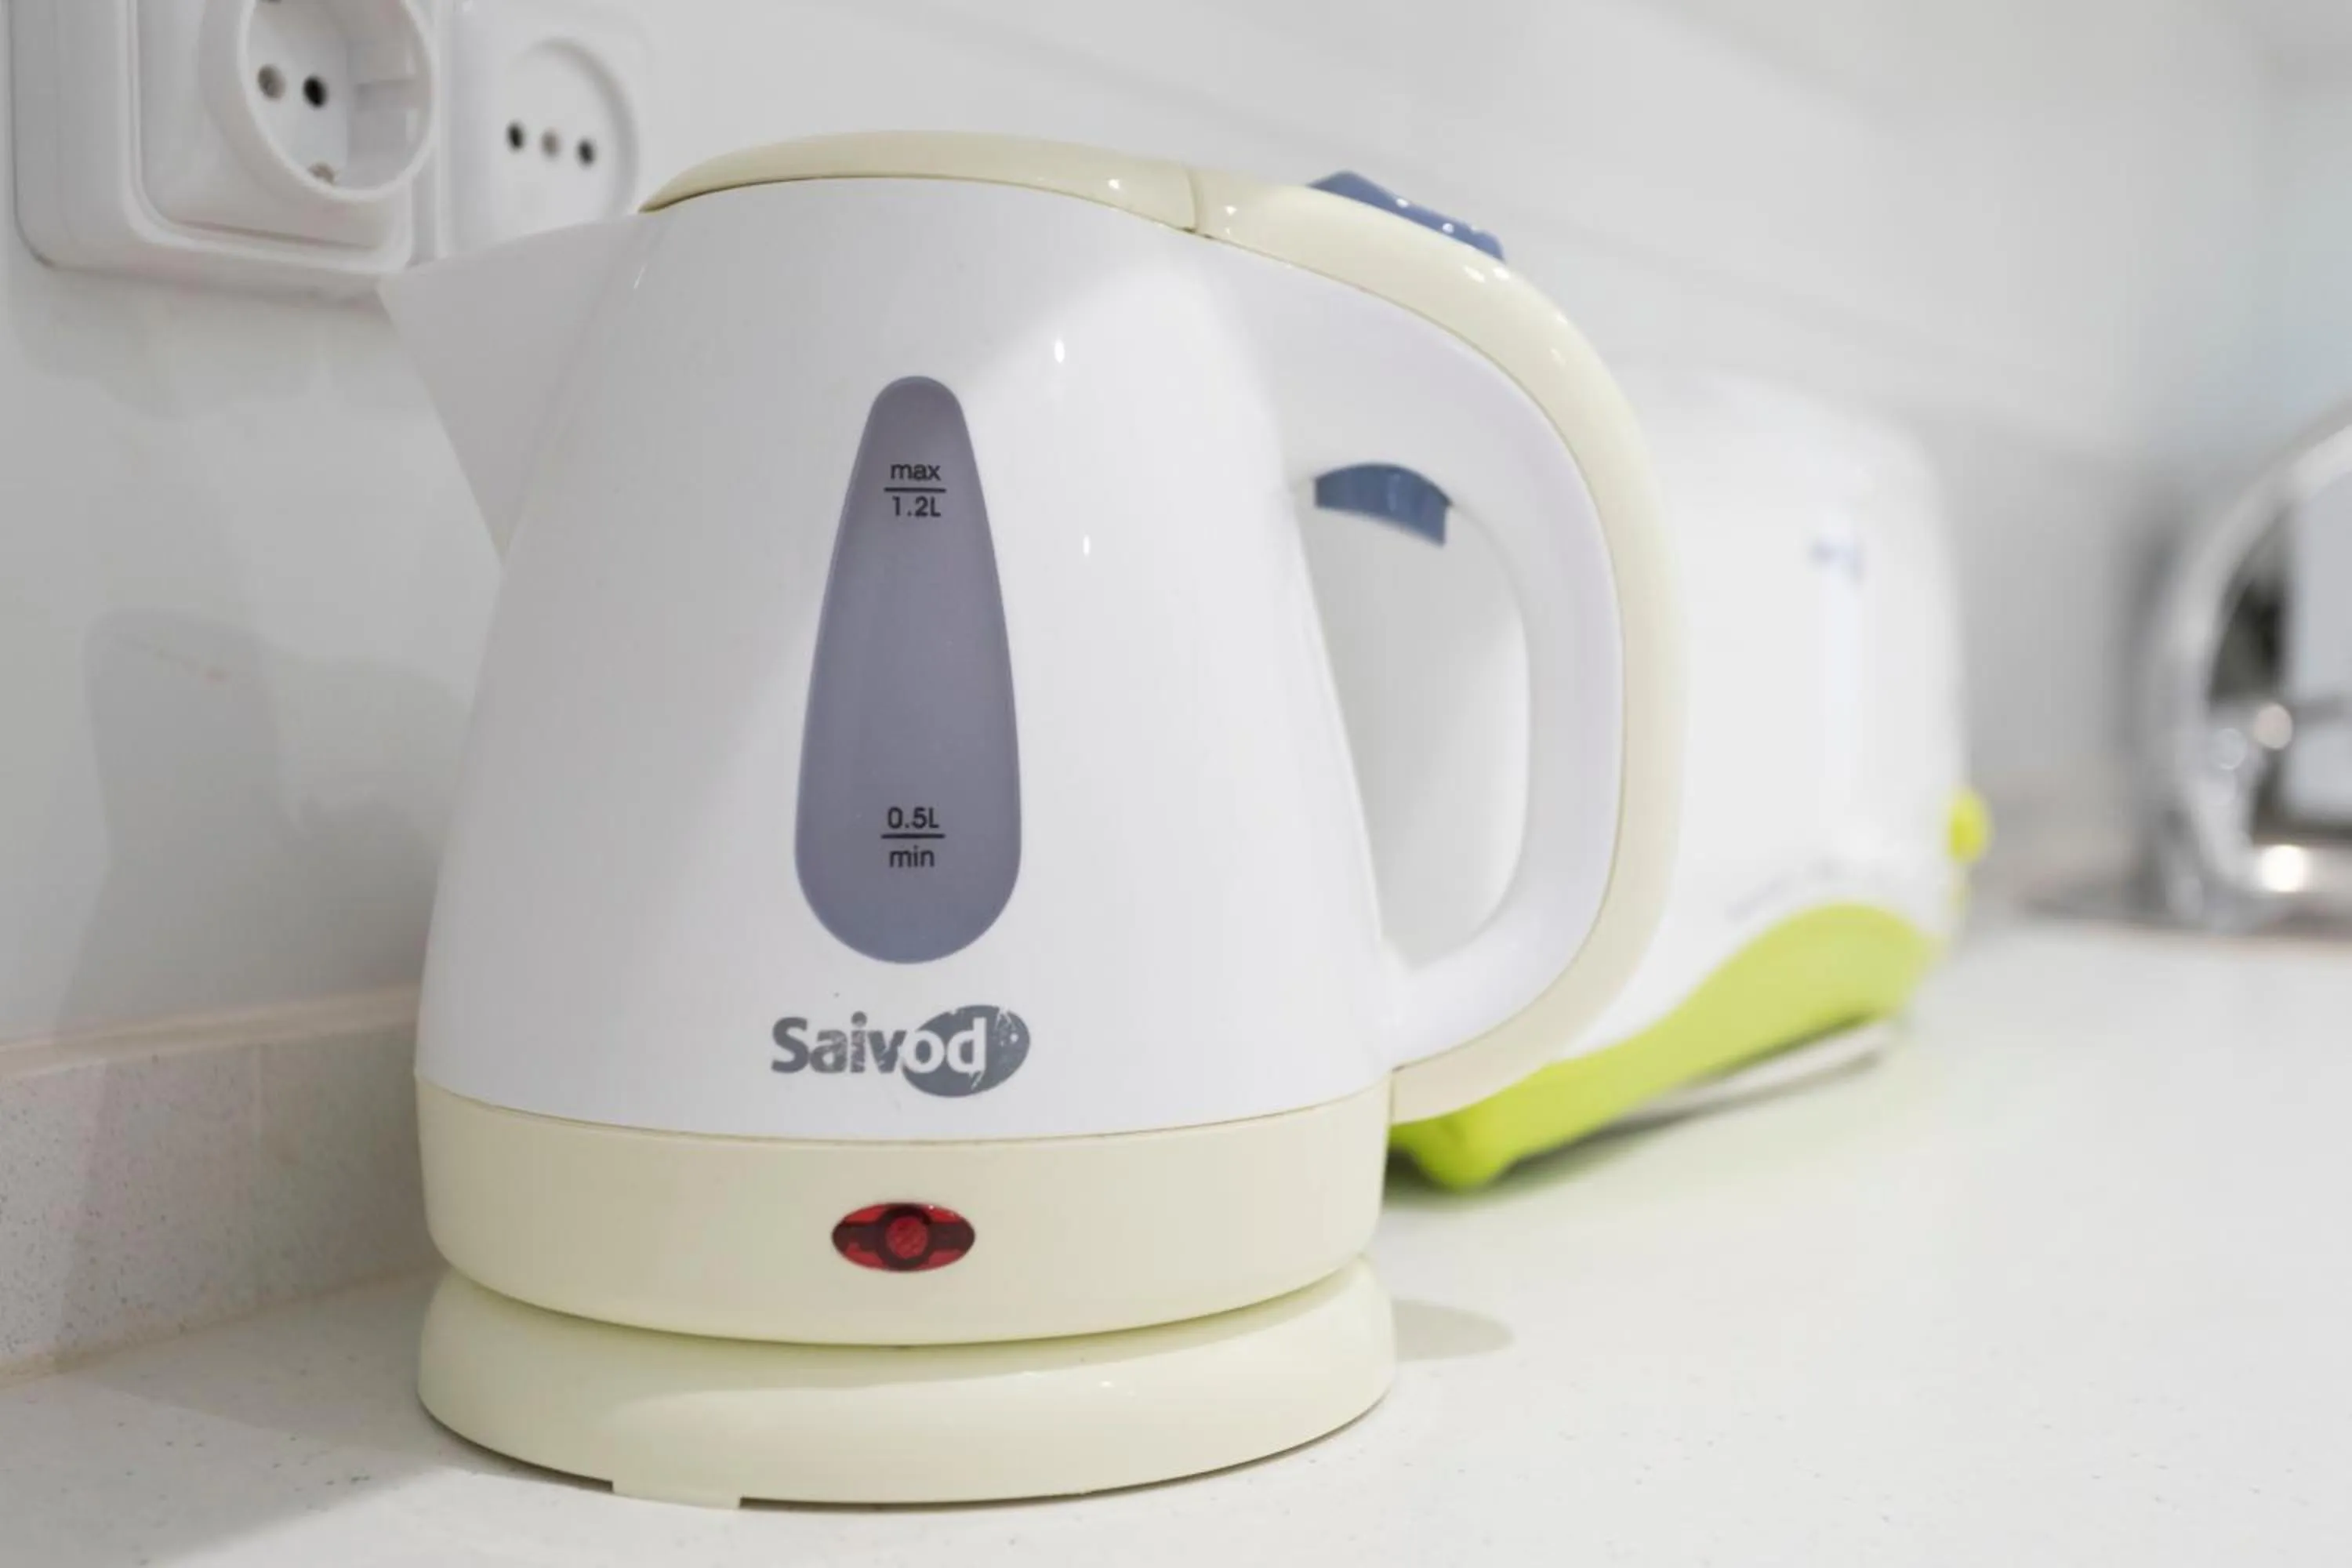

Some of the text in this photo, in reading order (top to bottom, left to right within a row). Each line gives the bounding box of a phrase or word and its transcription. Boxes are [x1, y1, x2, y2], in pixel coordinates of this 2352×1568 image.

[890, 463, 942, 481] max
[892, 495, 942, 517] 1.2L
[887, 806, 940, 829] 0.5L
[889, 844, 935, 868] min
[771, 1011, 987, 1075] Saivod
